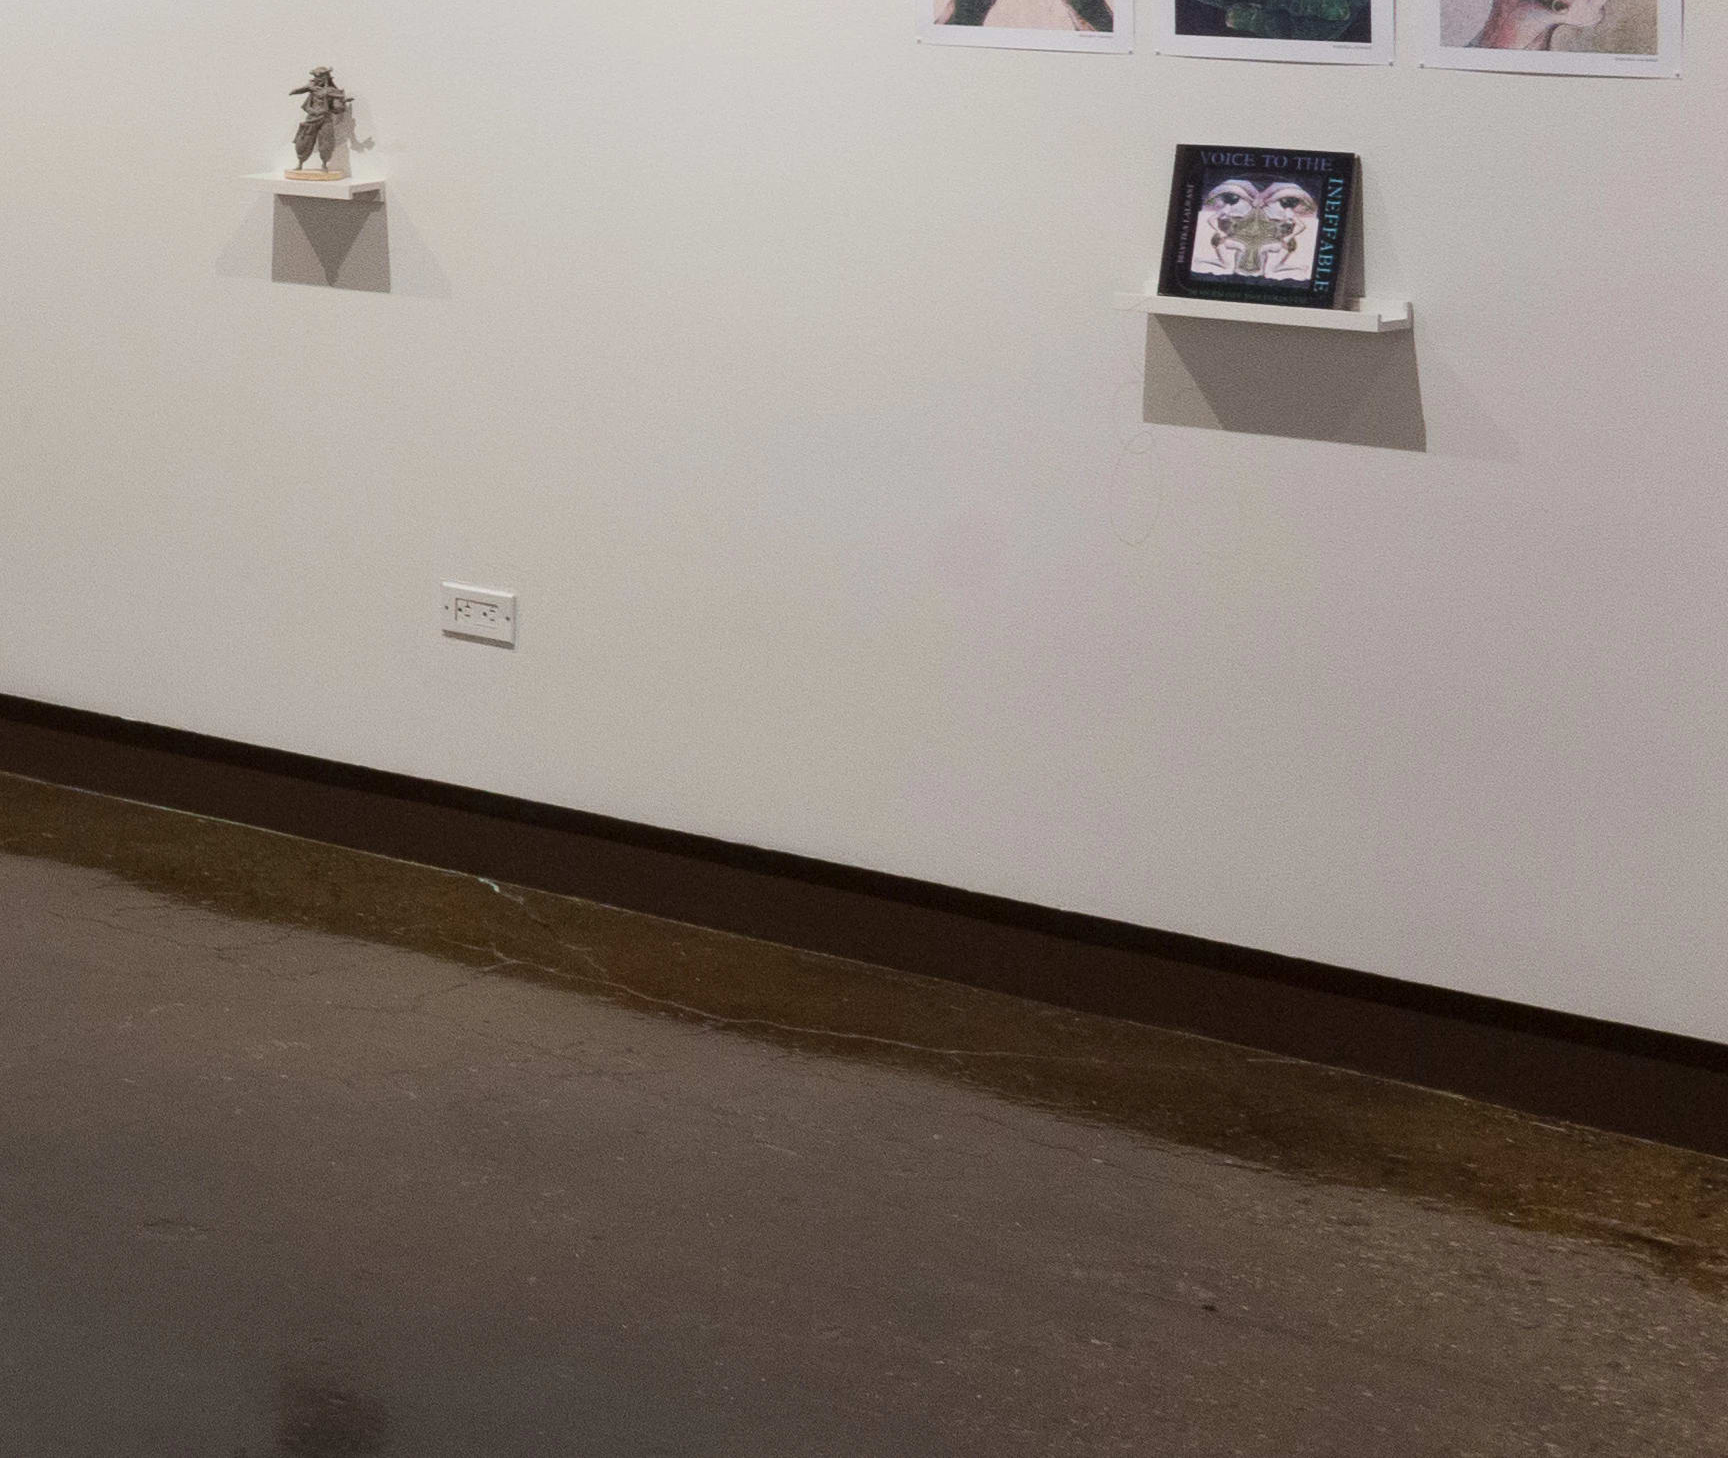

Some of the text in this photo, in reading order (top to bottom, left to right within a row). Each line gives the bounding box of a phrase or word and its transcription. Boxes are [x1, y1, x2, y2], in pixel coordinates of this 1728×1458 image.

[1200, 151, 1333, 171] VOICE TO THE
[1313, 177, 1344, 292] INEFFABLE
